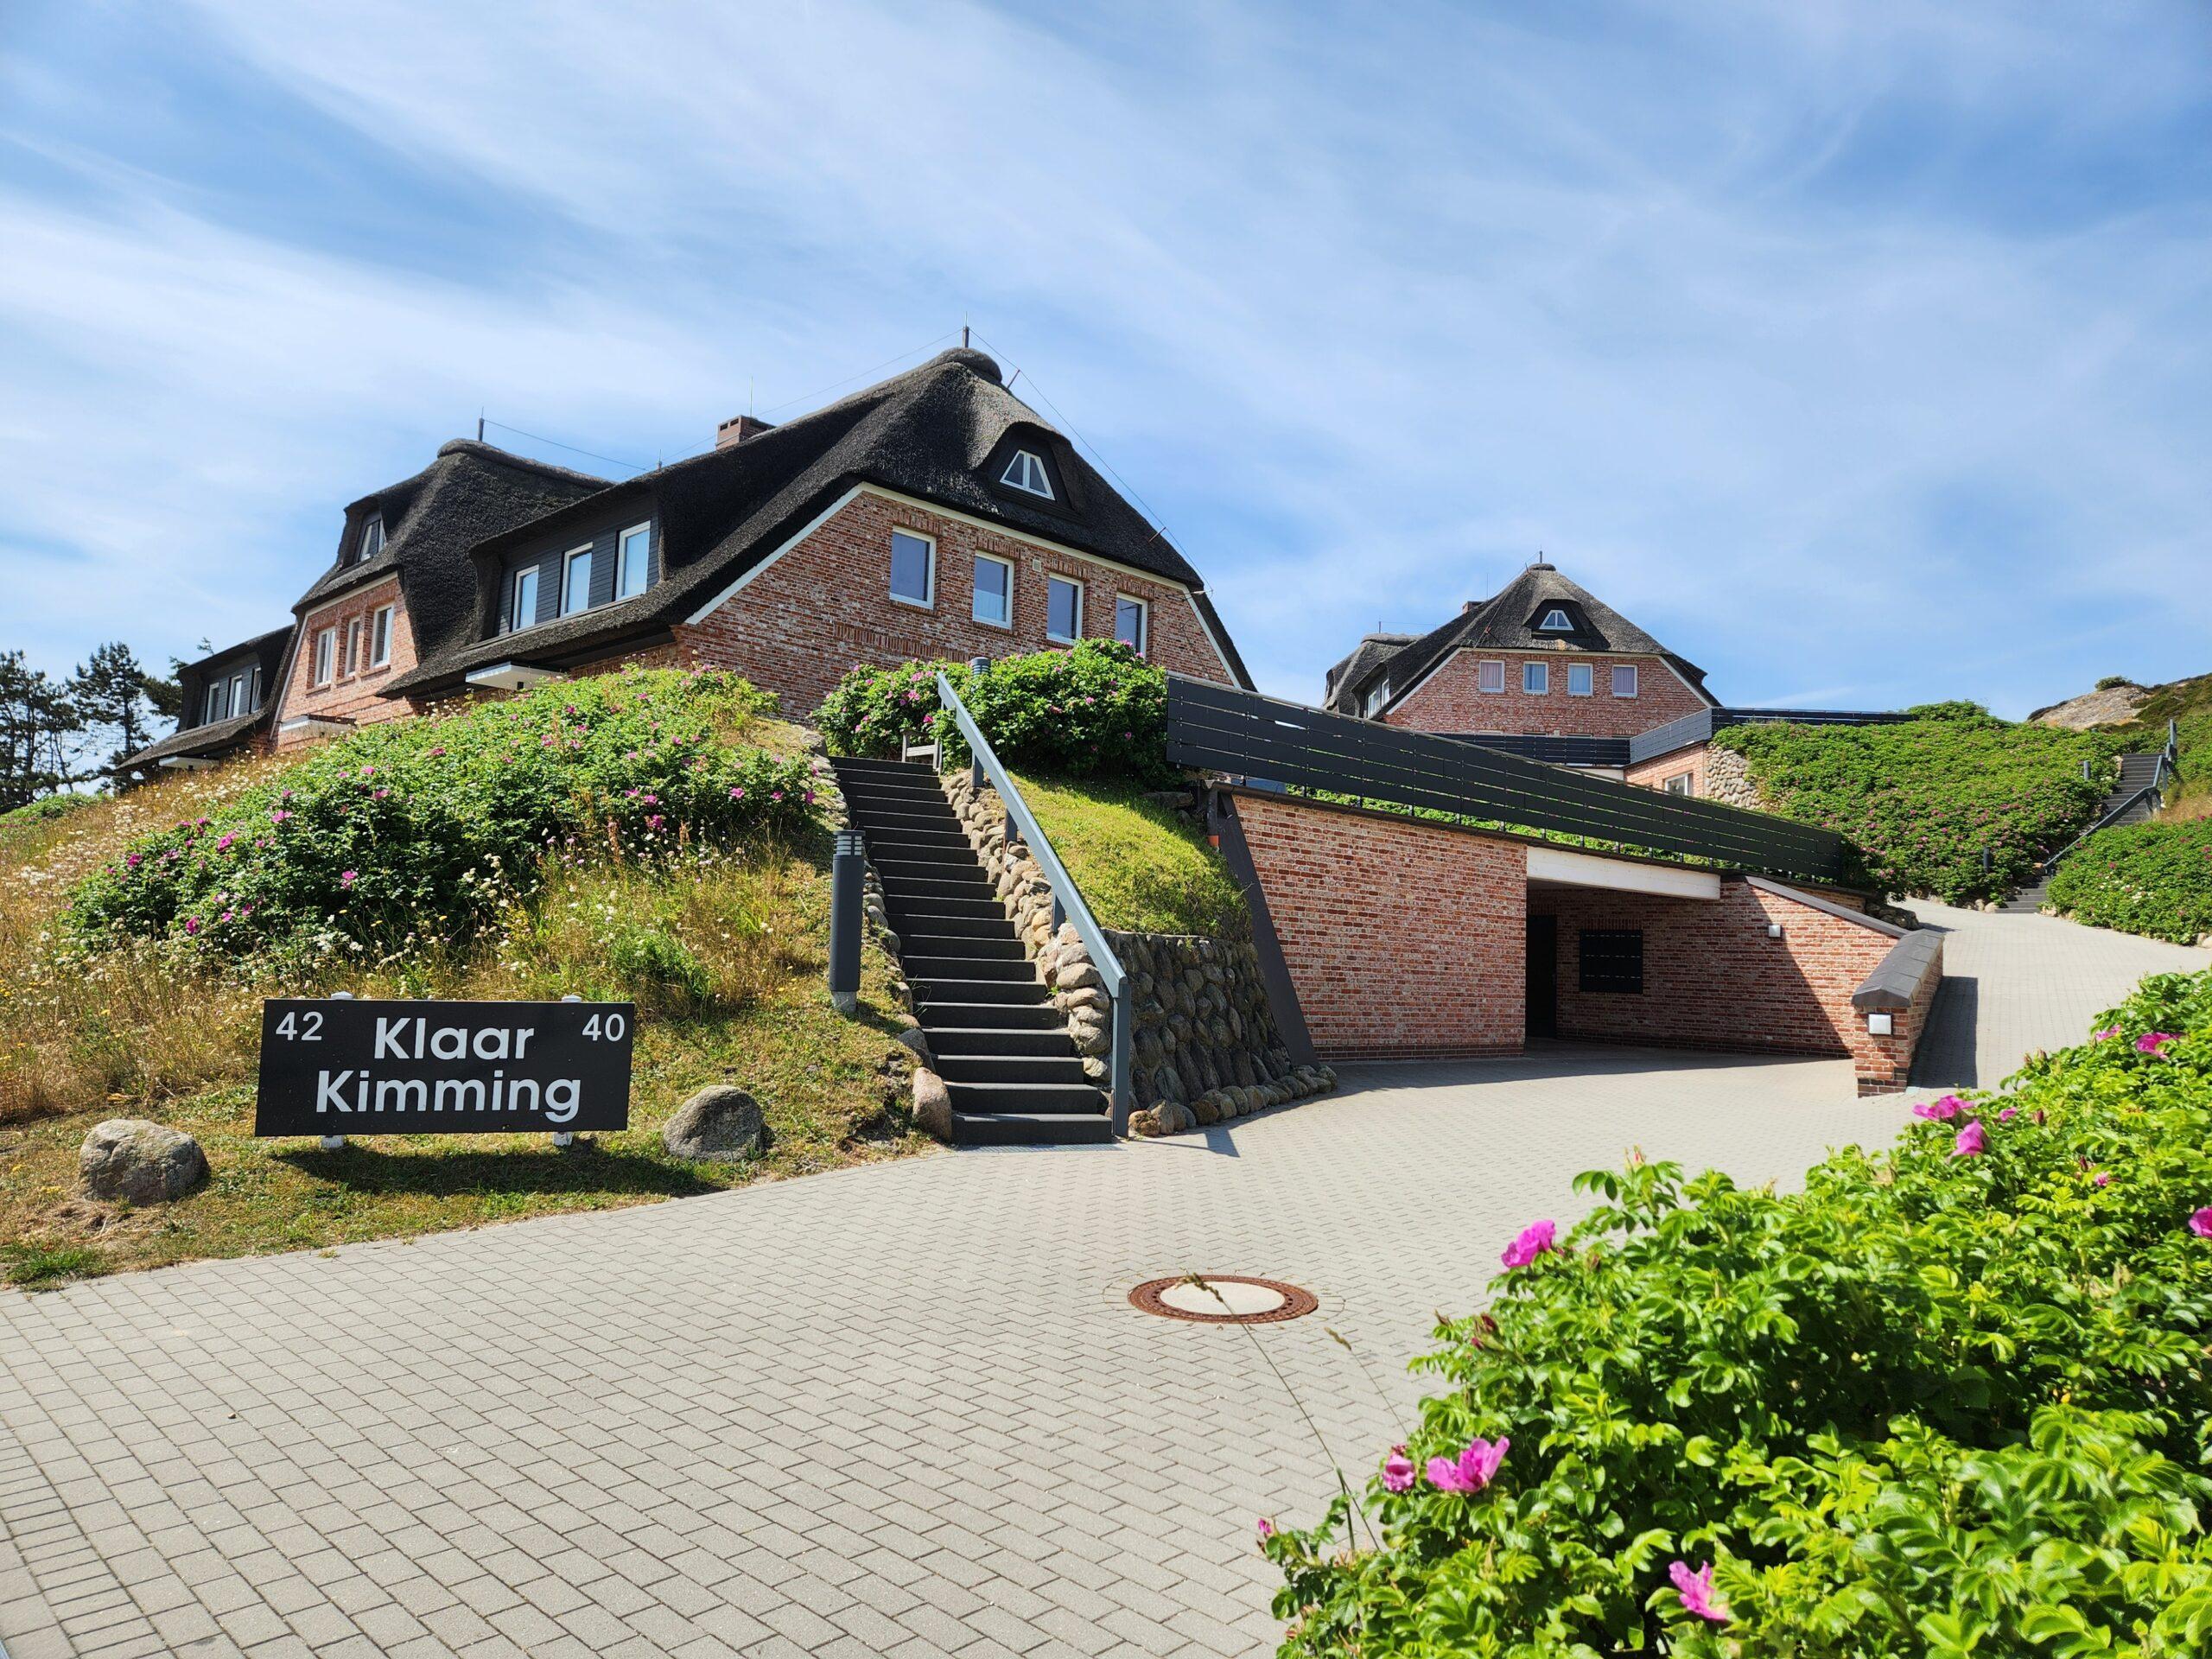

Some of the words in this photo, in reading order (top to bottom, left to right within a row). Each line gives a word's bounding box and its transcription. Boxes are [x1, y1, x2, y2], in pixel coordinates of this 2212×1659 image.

[276, 1011, 323, 1040] 42
[374, 1017, 535, 1060] Klaar
[582, 1014, 625, 1042] 40
[315, 1070, 581, 1122] Kimming
